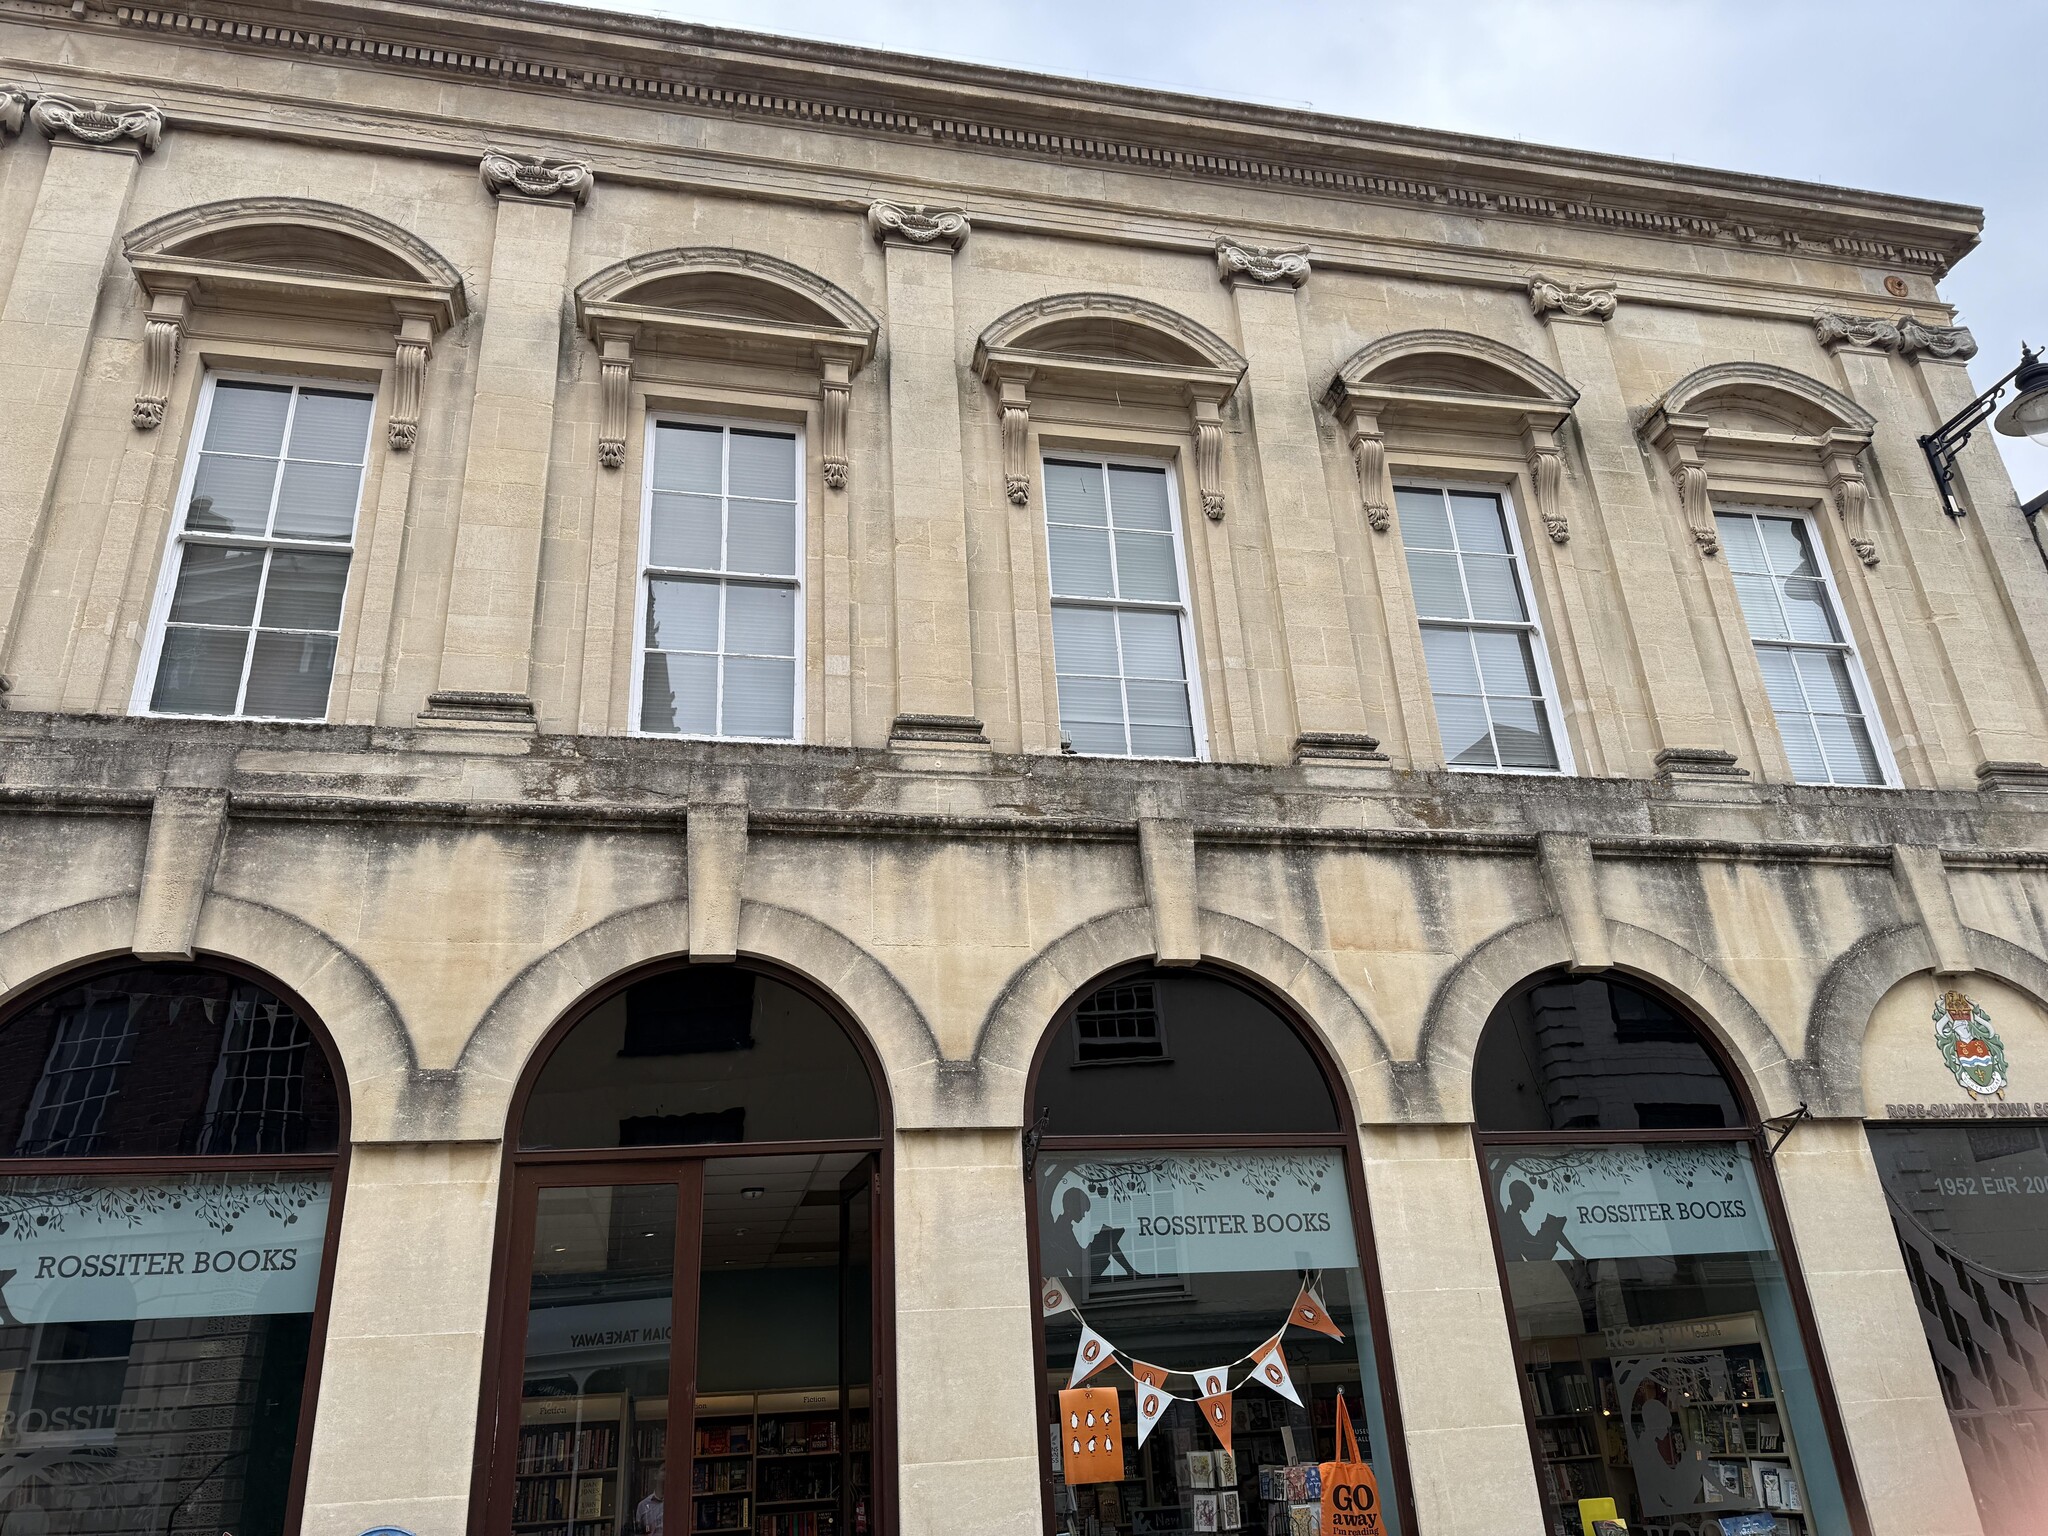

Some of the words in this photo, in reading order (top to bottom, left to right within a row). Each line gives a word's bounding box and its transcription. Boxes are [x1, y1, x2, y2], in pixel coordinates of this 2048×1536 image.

[1885, 1103, 1987, 1118] ROSS-ON-WYE
[1987, 1102, 2031, 1118] TOWN
[1935, 1177, 1979, 1195] 1952
[1576, 1202, 1675, 1225] ROSSITER
[1676, 1199, 1747, 1220] BOOKS
[1137, 1214, 1249, 1238] ROSSITER
[1252, 1212, 1331, 1235] BOOKS
[34, 1252, 184, 1279] ROSSITER
[191, 1248, 298, 1275] BOOKS
[1332, 1484, 1374, 1512] GO
[1332, 1513, 1377, 1528] away
[1348, 1527, 1380, 1536] reading
